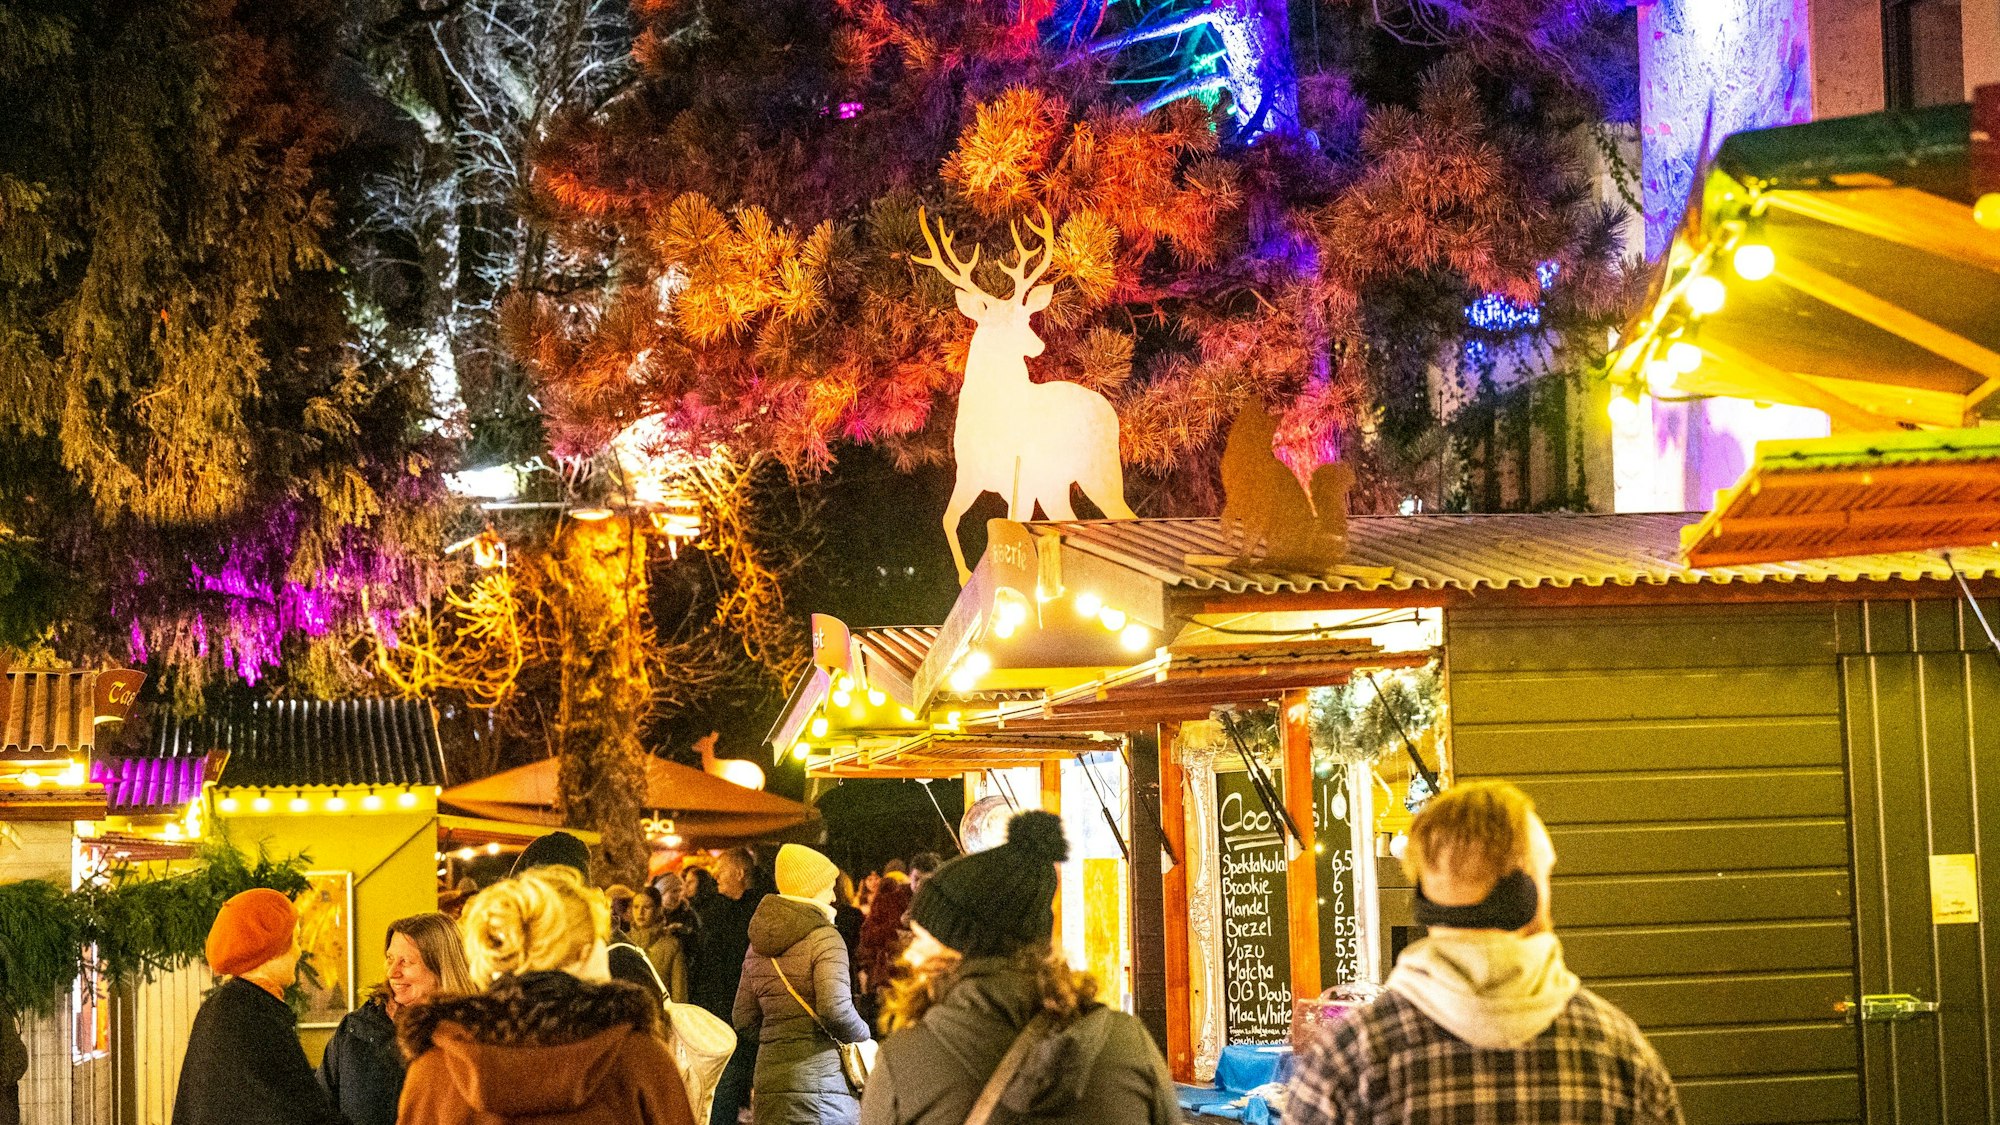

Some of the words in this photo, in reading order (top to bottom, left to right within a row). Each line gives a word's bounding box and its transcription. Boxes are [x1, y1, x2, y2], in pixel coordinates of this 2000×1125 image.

[1223, 851, 1286, 879] Spektakula
[1222, 873, 1273, 895] Brookie
[1225, 895, 1269, 917] Mandel
[1334, 892, 1344, 915] 6
[1226, 916, 1272, 937] Brezel
[1226, 938, 1265, 960] Yuzu
[1228, 958, 1274, 981] Matcha
[1227, 980, 1254, 1003] OG
[1258, 981, 1291, 1003] Doub
[1256, 1000, 1292, 1026] White
